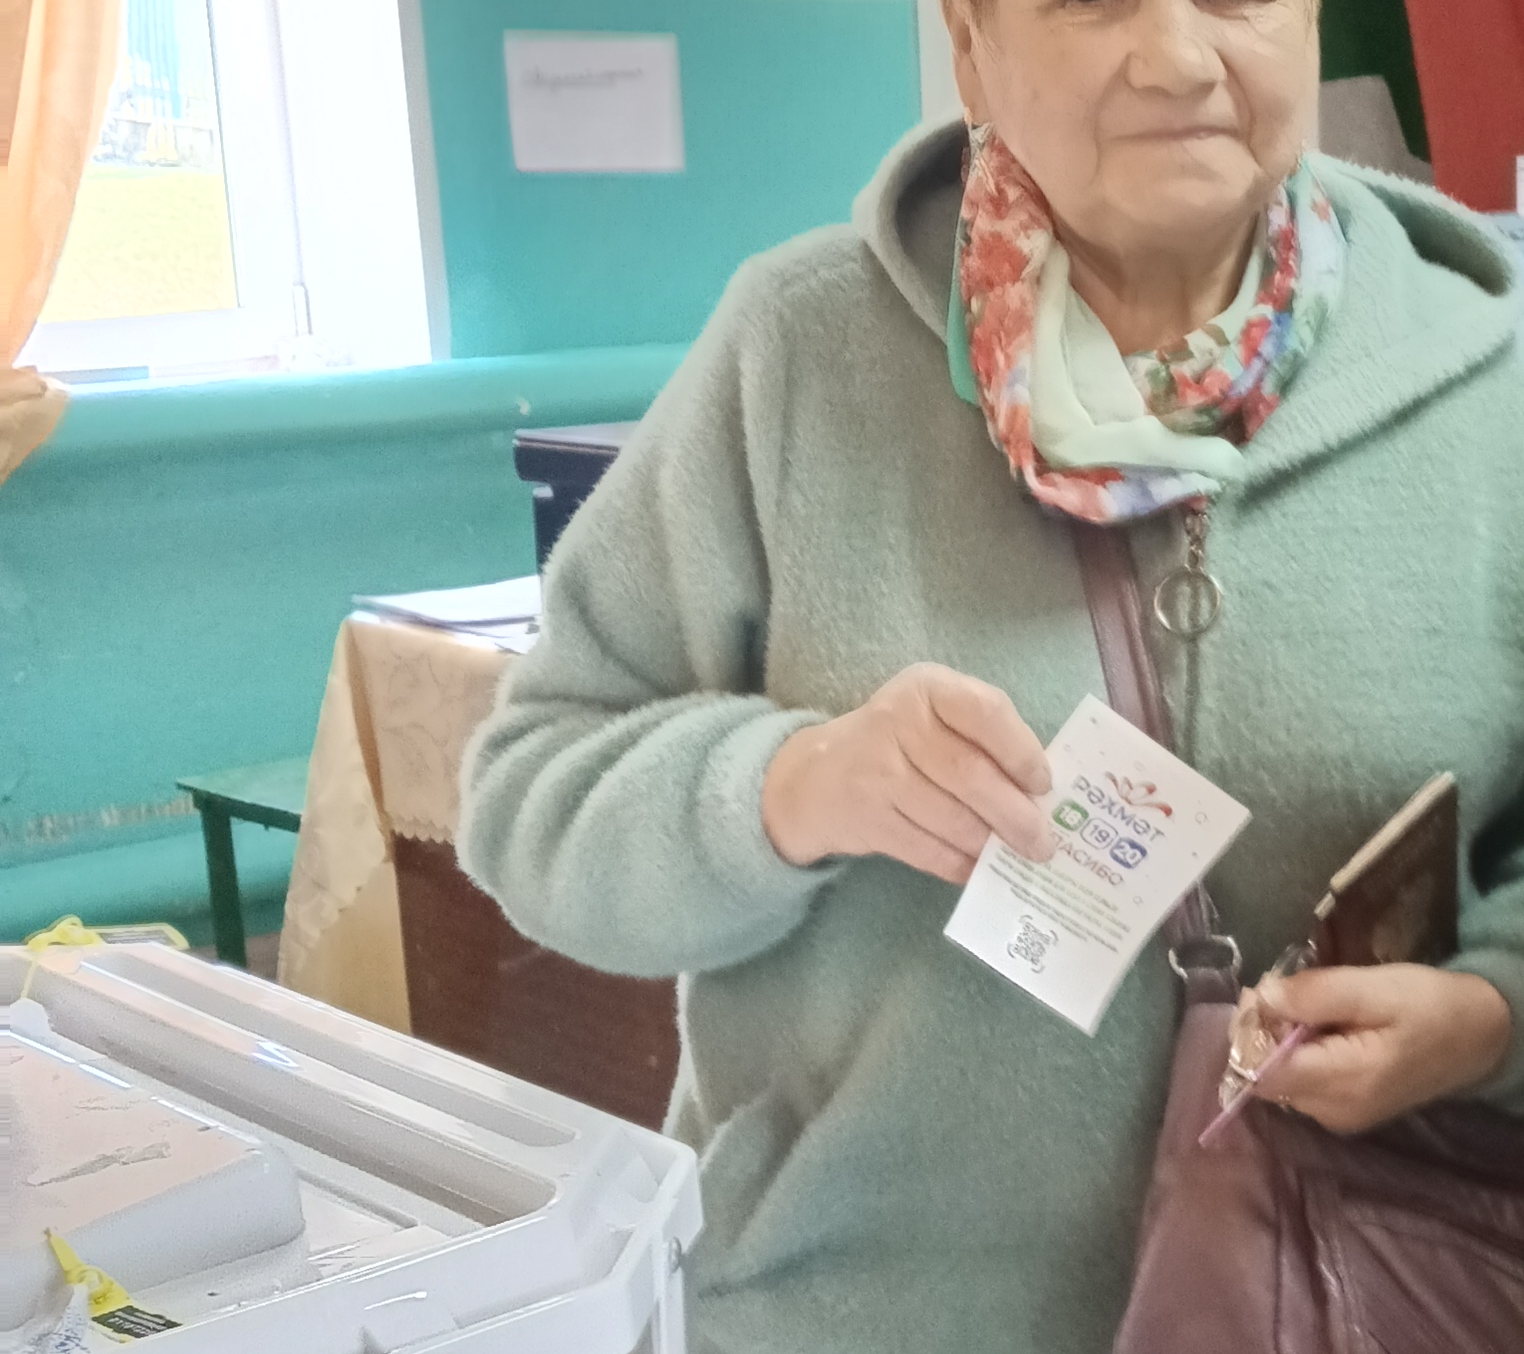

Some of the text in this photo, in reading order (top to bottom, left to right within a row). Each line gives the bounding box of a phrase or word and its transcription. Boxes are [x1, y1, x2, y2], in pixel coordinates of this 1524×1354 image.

[1049, 830, 1125, 886] ПАСИБО
[1089, 824, 1110, 844] 19
[1112, 843, 1140, 866] 20
